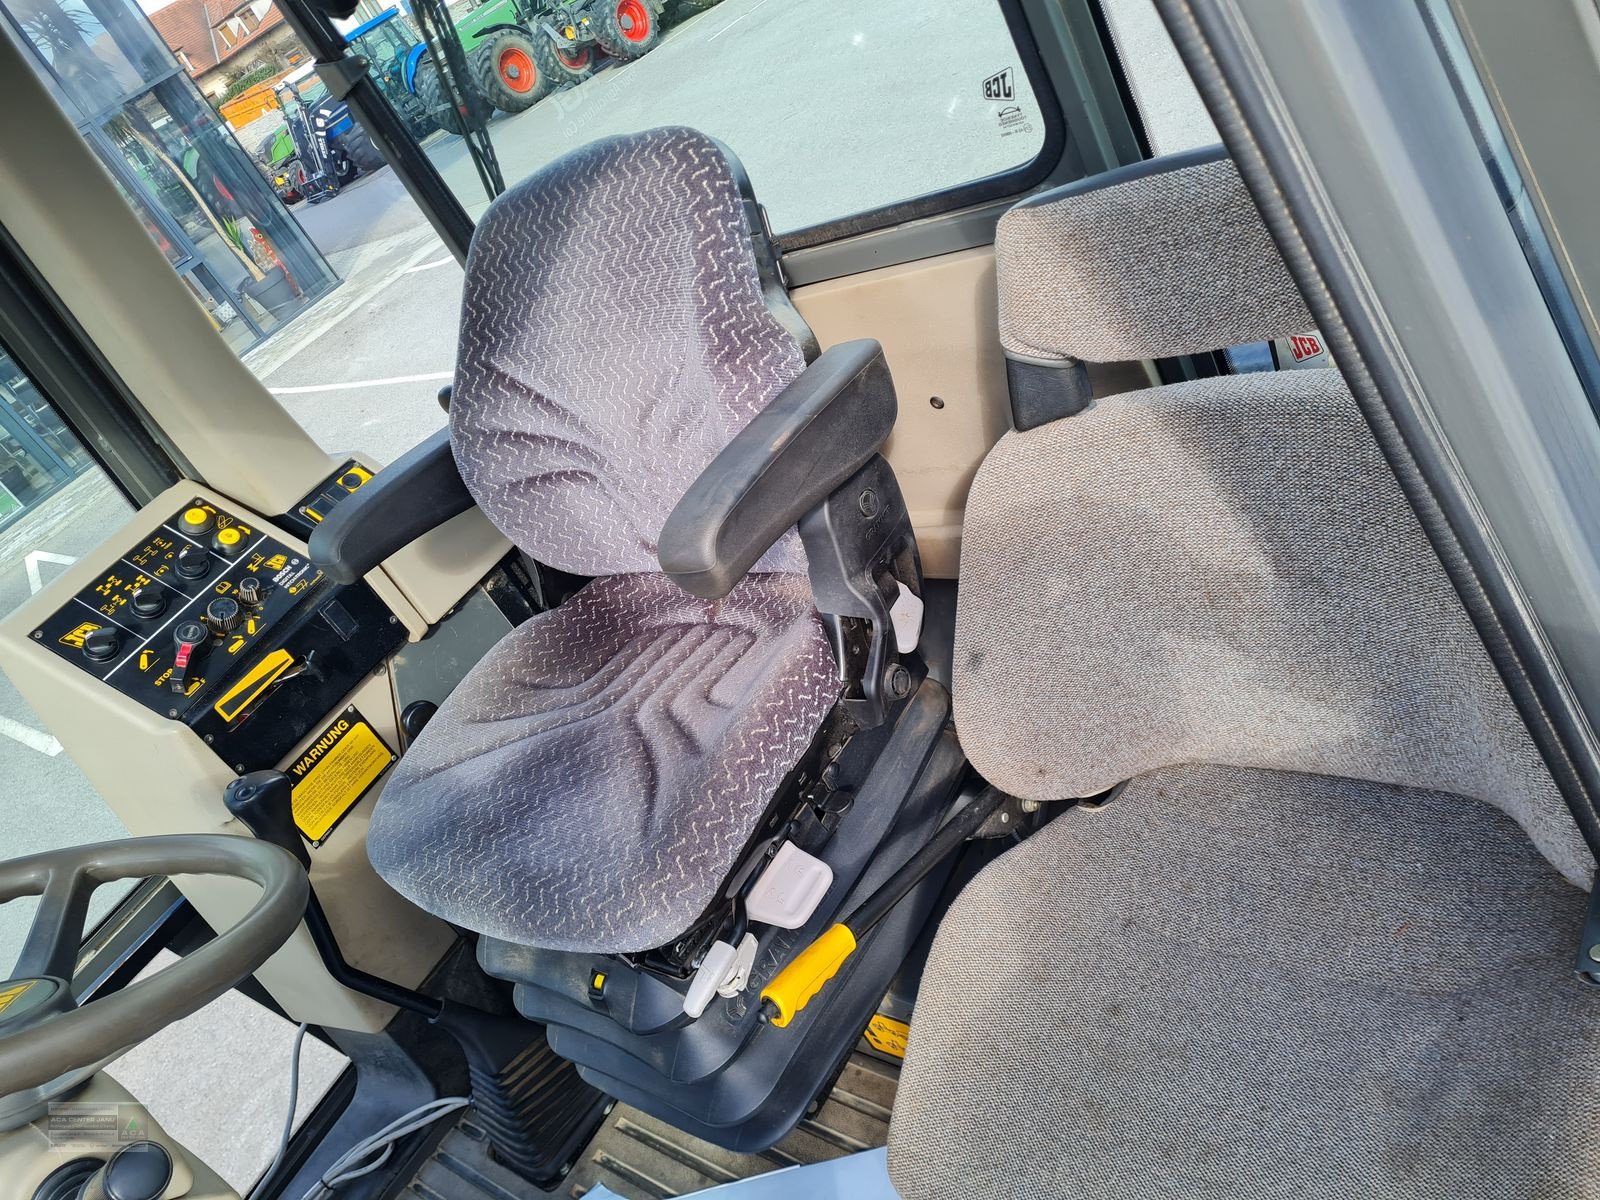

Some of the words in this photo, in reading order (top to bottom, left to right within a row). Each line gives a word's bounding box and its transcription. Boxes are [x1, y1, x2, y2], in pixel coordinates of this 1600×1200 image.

[1290, 335, 1320, 360] JCB
[272, 564, 293, 582] BOSCH
[279, 571, 295, 586] DIGITAL
[154, 668, 173, 687] STOP
[292, 719, 350, 777] WARNUNG
